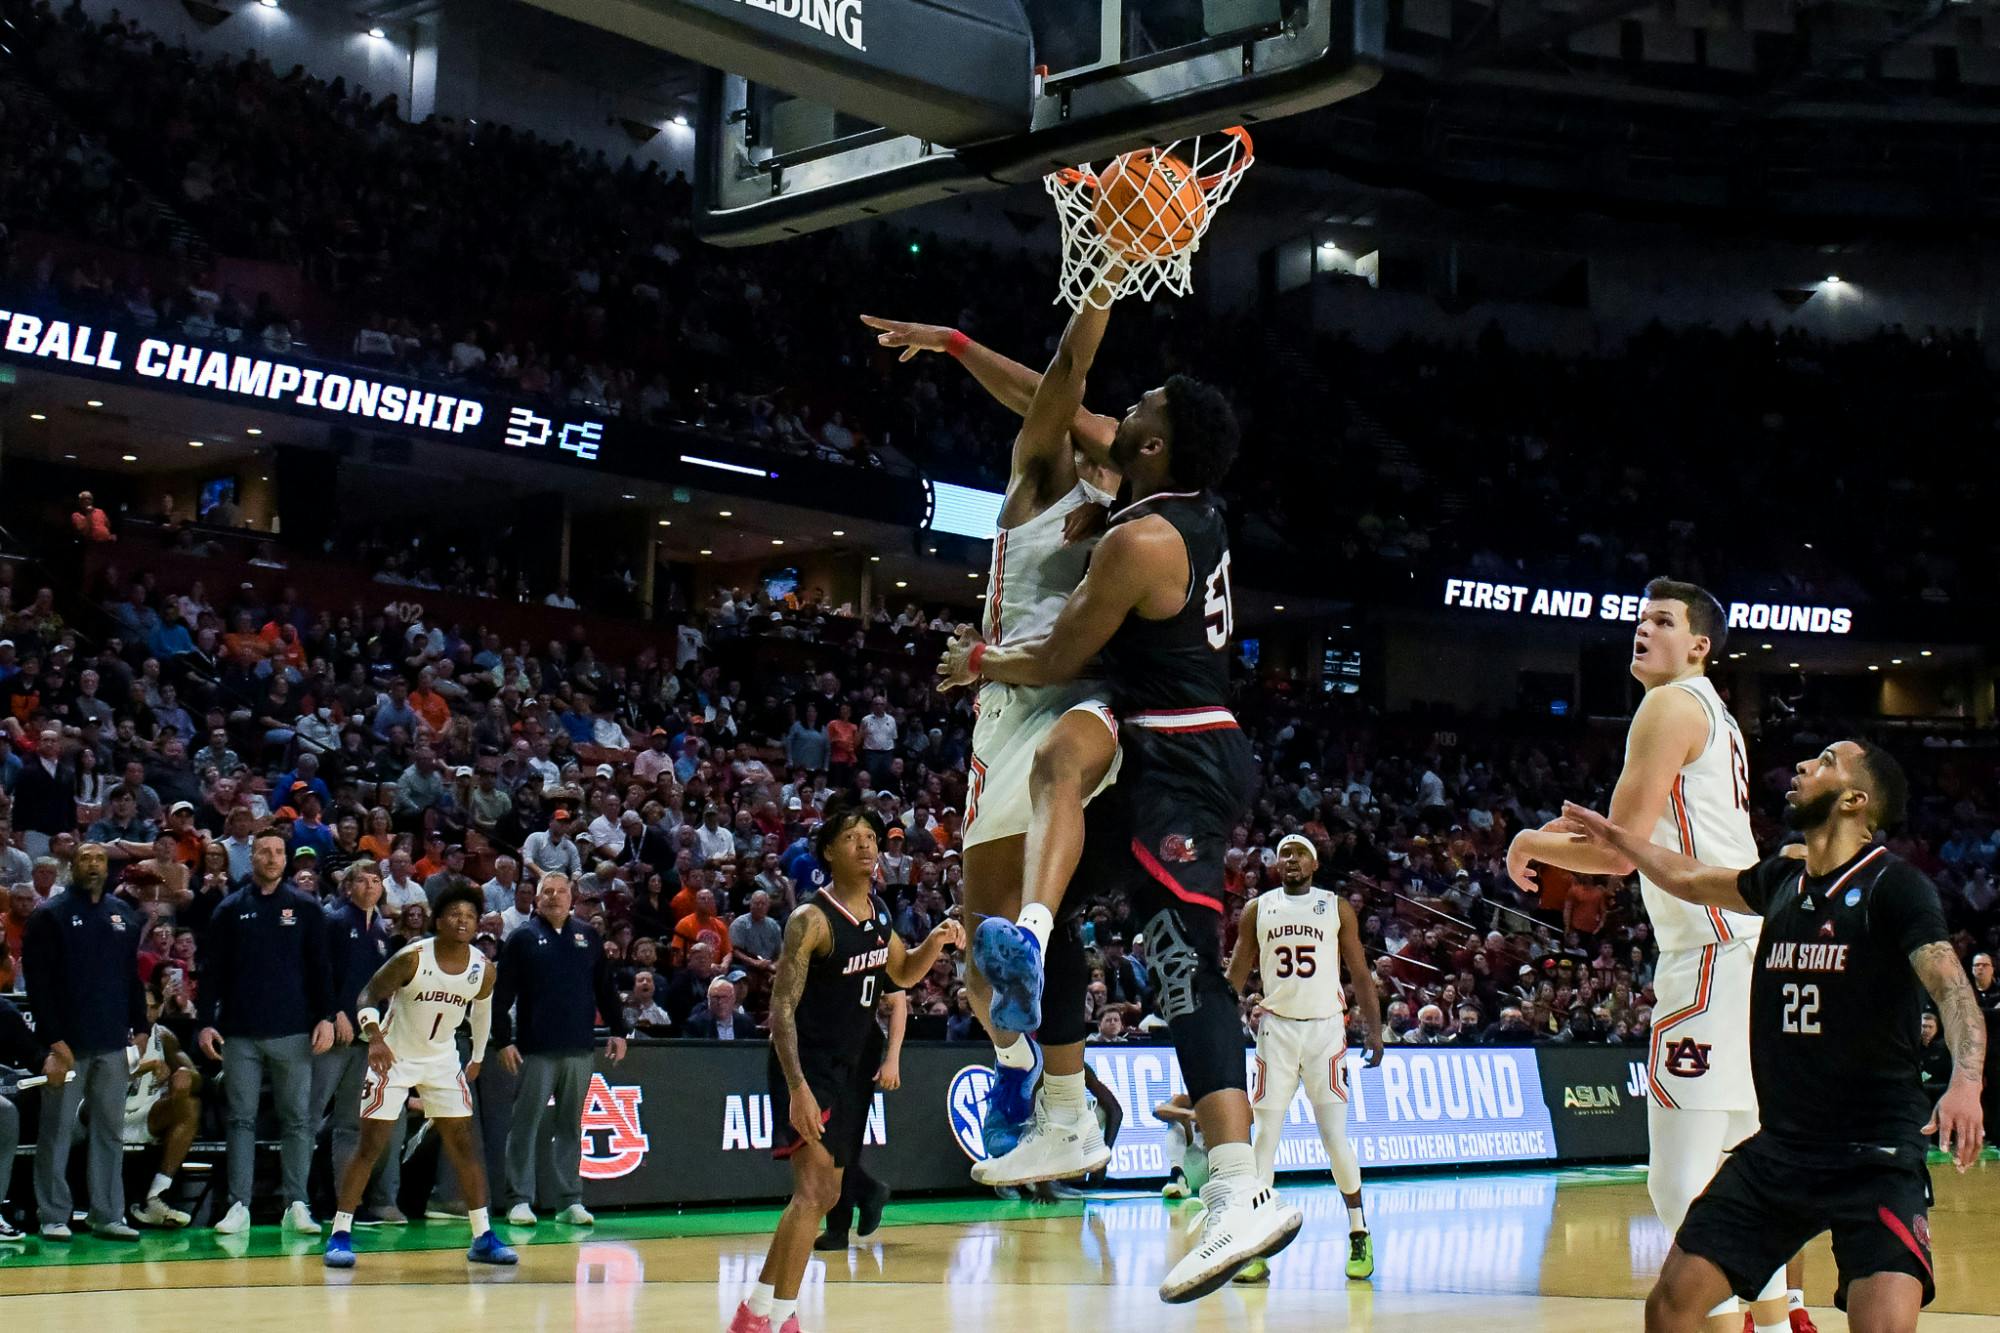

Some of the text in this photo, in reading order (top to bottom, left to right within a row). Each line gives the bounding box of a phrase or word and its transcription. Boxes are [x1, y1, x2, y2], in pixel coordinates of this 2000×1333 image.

[0, 310, 483, 433] BALL CHAMPIONSHIP
[1204, 549, 1233, 650] 5
[1444, 578, 1528, 612] FIRST
[1530, 588, 1593, 618] AND
[1728, 602, 1852, 633] ROUNDS
[1266, 924, 1324, 942] AUBURN
[1274, 945, 1316, 978] 35
[1766, 942, 1848, 971] JAX STATE
[860, 975, 876, 1007] 0
[1782, 983, 1821, 1034] 22
[429, 1012, 444, 1041] 1
[1380, 1054, 1525, 1122] ROUND
[1564, 1085, 1621, 1108] ASUN
[722, 1093, 887, 1150] AUN
[1107, 1144, 1164, 1173] STED
[1378, 1134, 1457, 1161] SOUTHERN
[1458, 1131, 1546, 1157] CONFERENCE
